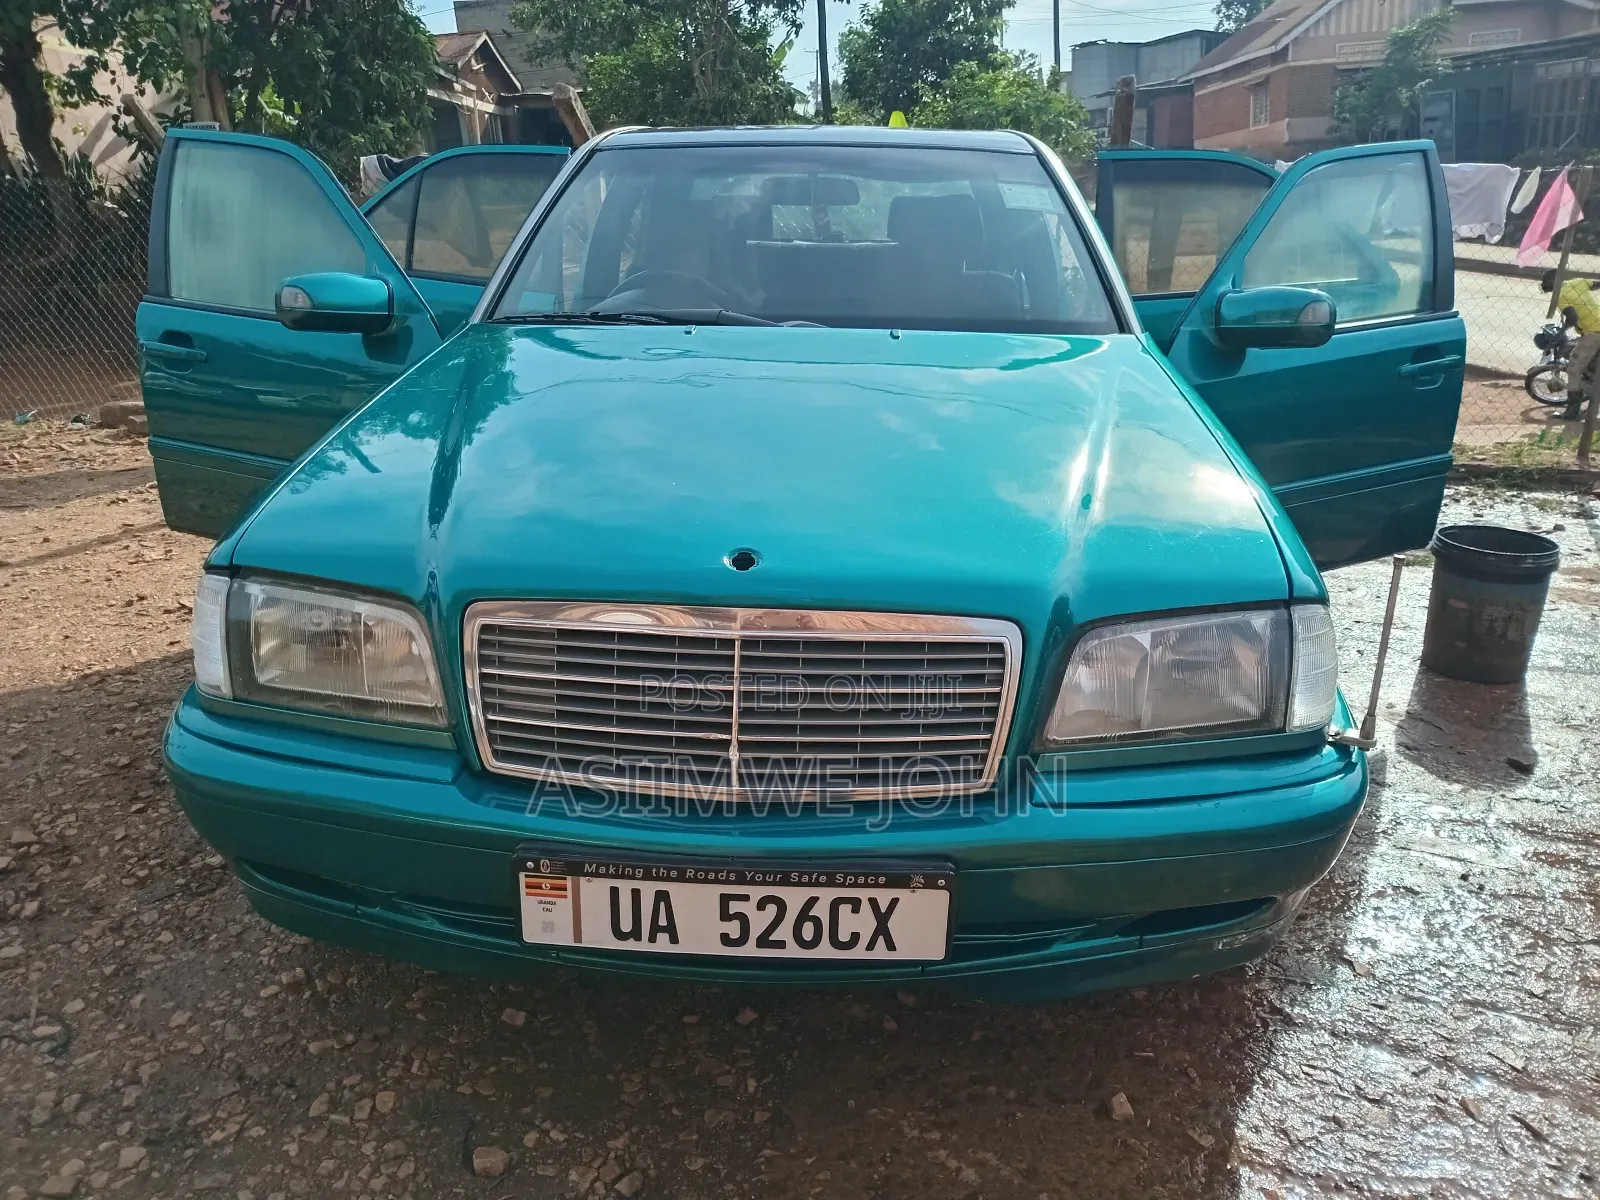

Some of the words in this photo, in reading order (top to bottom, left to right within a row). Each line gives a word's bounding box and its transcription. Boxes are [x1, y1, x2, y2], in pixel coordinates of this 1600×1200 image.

[583, 863, 644, 878] Making
[651, 867, 678, 878] the
[685, 868, 737, 881] Roads
[744, 871, 783, 883] Your
[789, 872, 828, 883] Safe
[835, 873, 887, 886] Space
[609, 885, 680, 946] UA
[718, 892, 900, 953] 526CX
